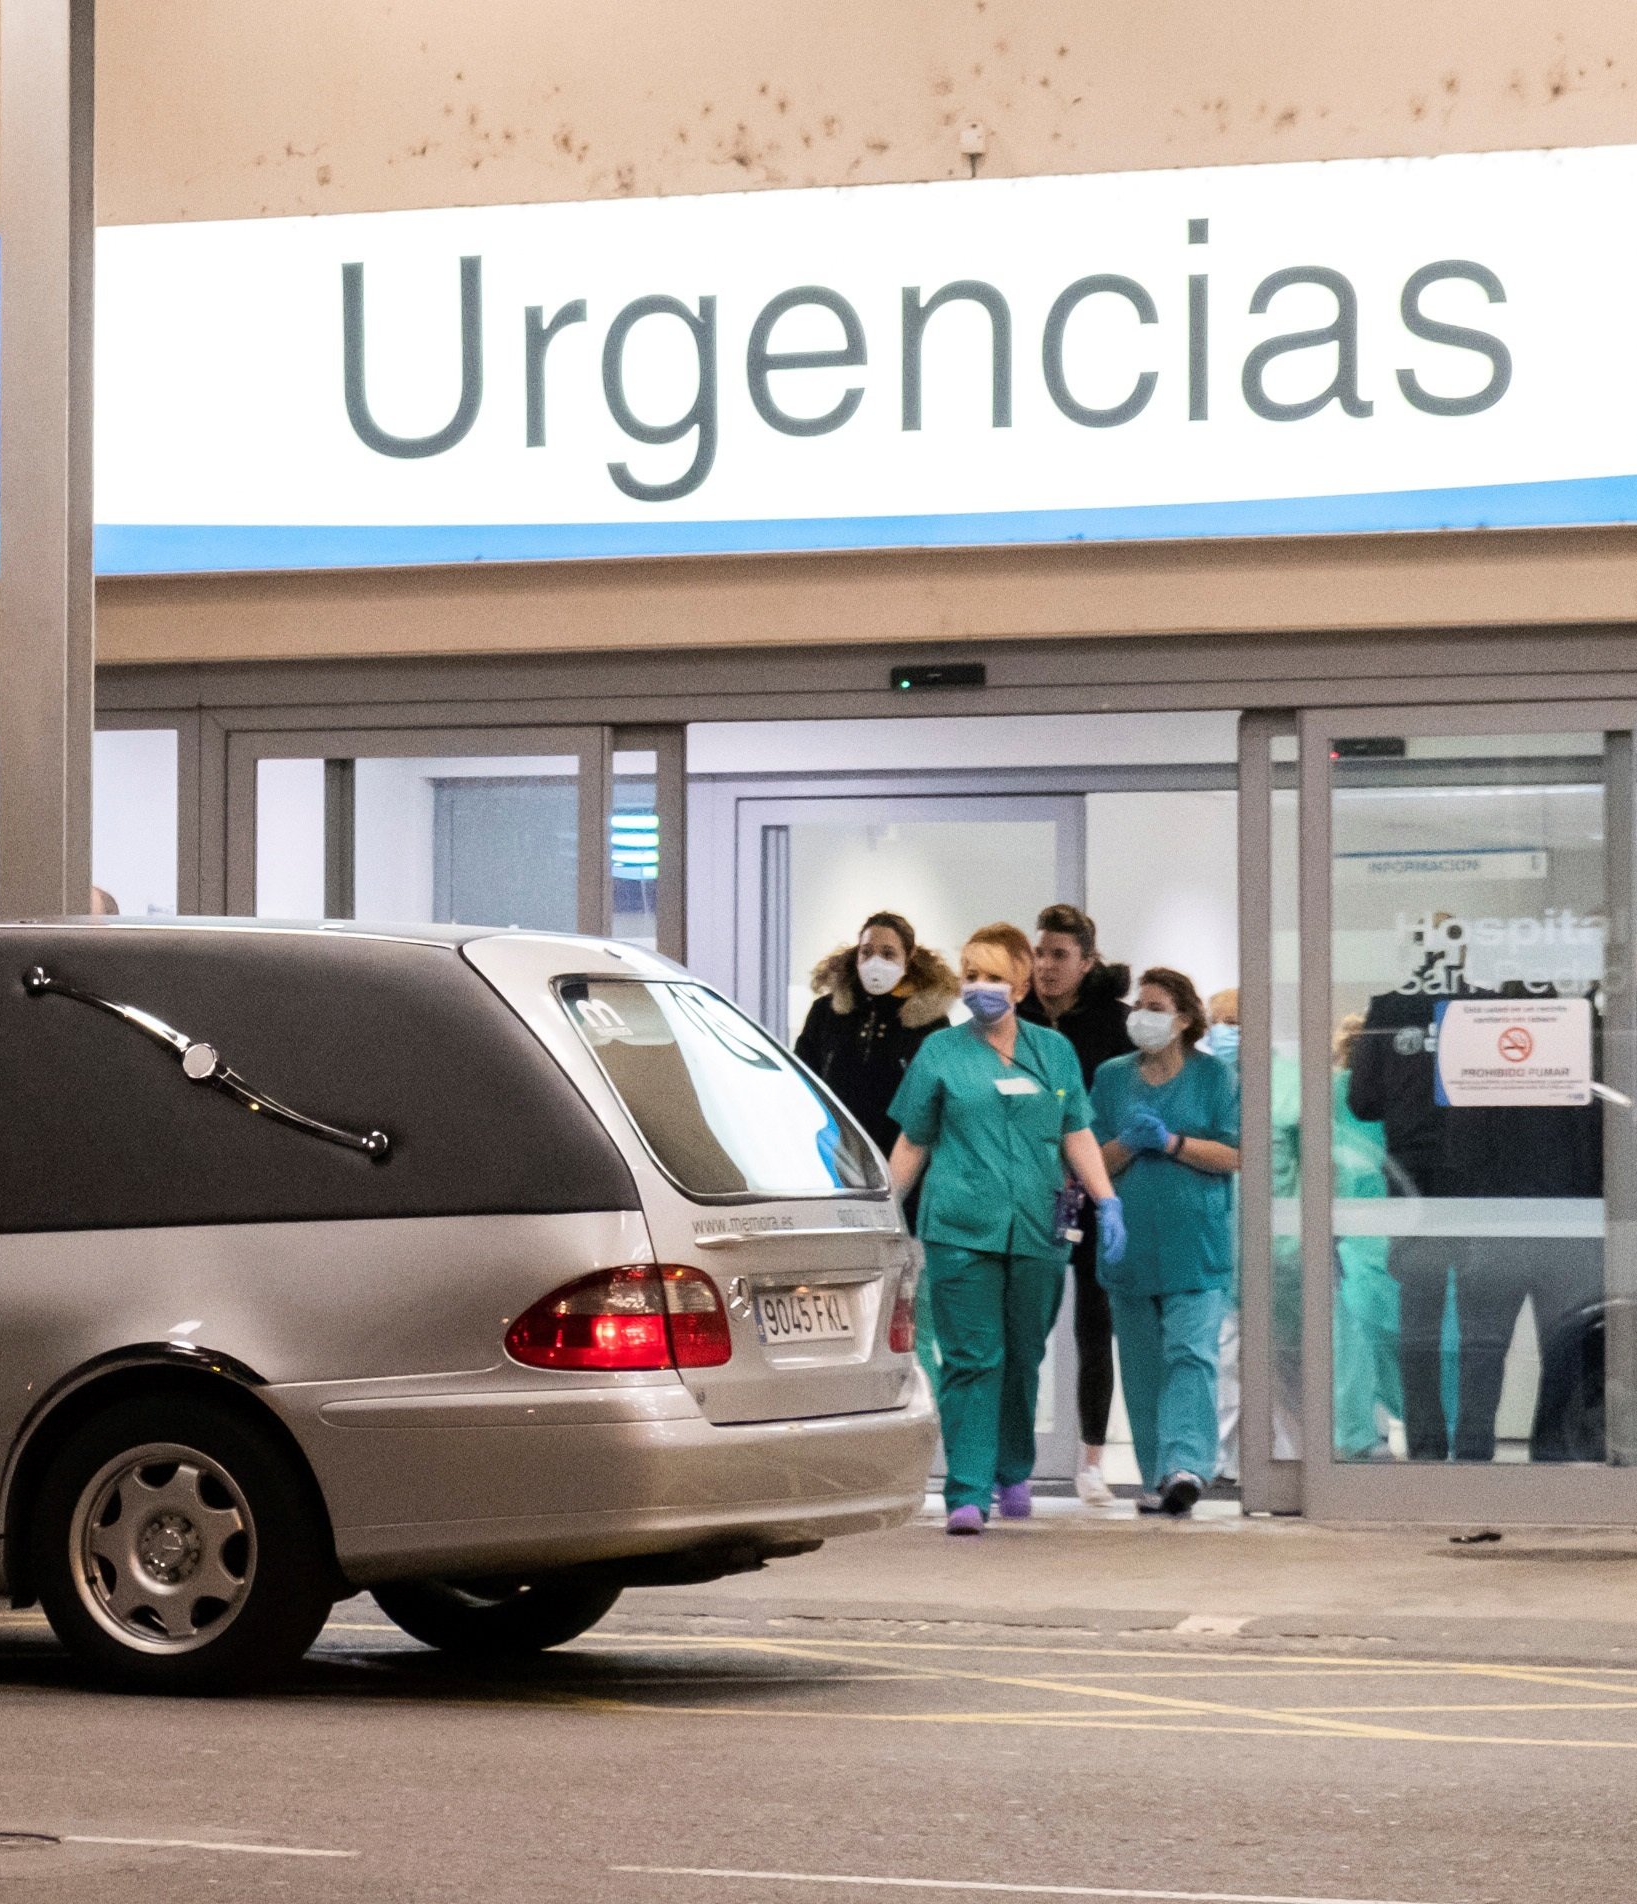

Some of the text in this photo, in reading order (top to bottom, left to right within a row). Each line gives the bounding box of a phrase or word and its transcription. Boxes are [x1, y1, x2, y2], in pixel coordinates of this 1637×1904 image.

[340, 217, 1514, 503] Urgencias
[1461, 1067, 1571, 1078] PROHIBIDO FUMAR
[764, 1295, 850, 1336] 9045 FKL
